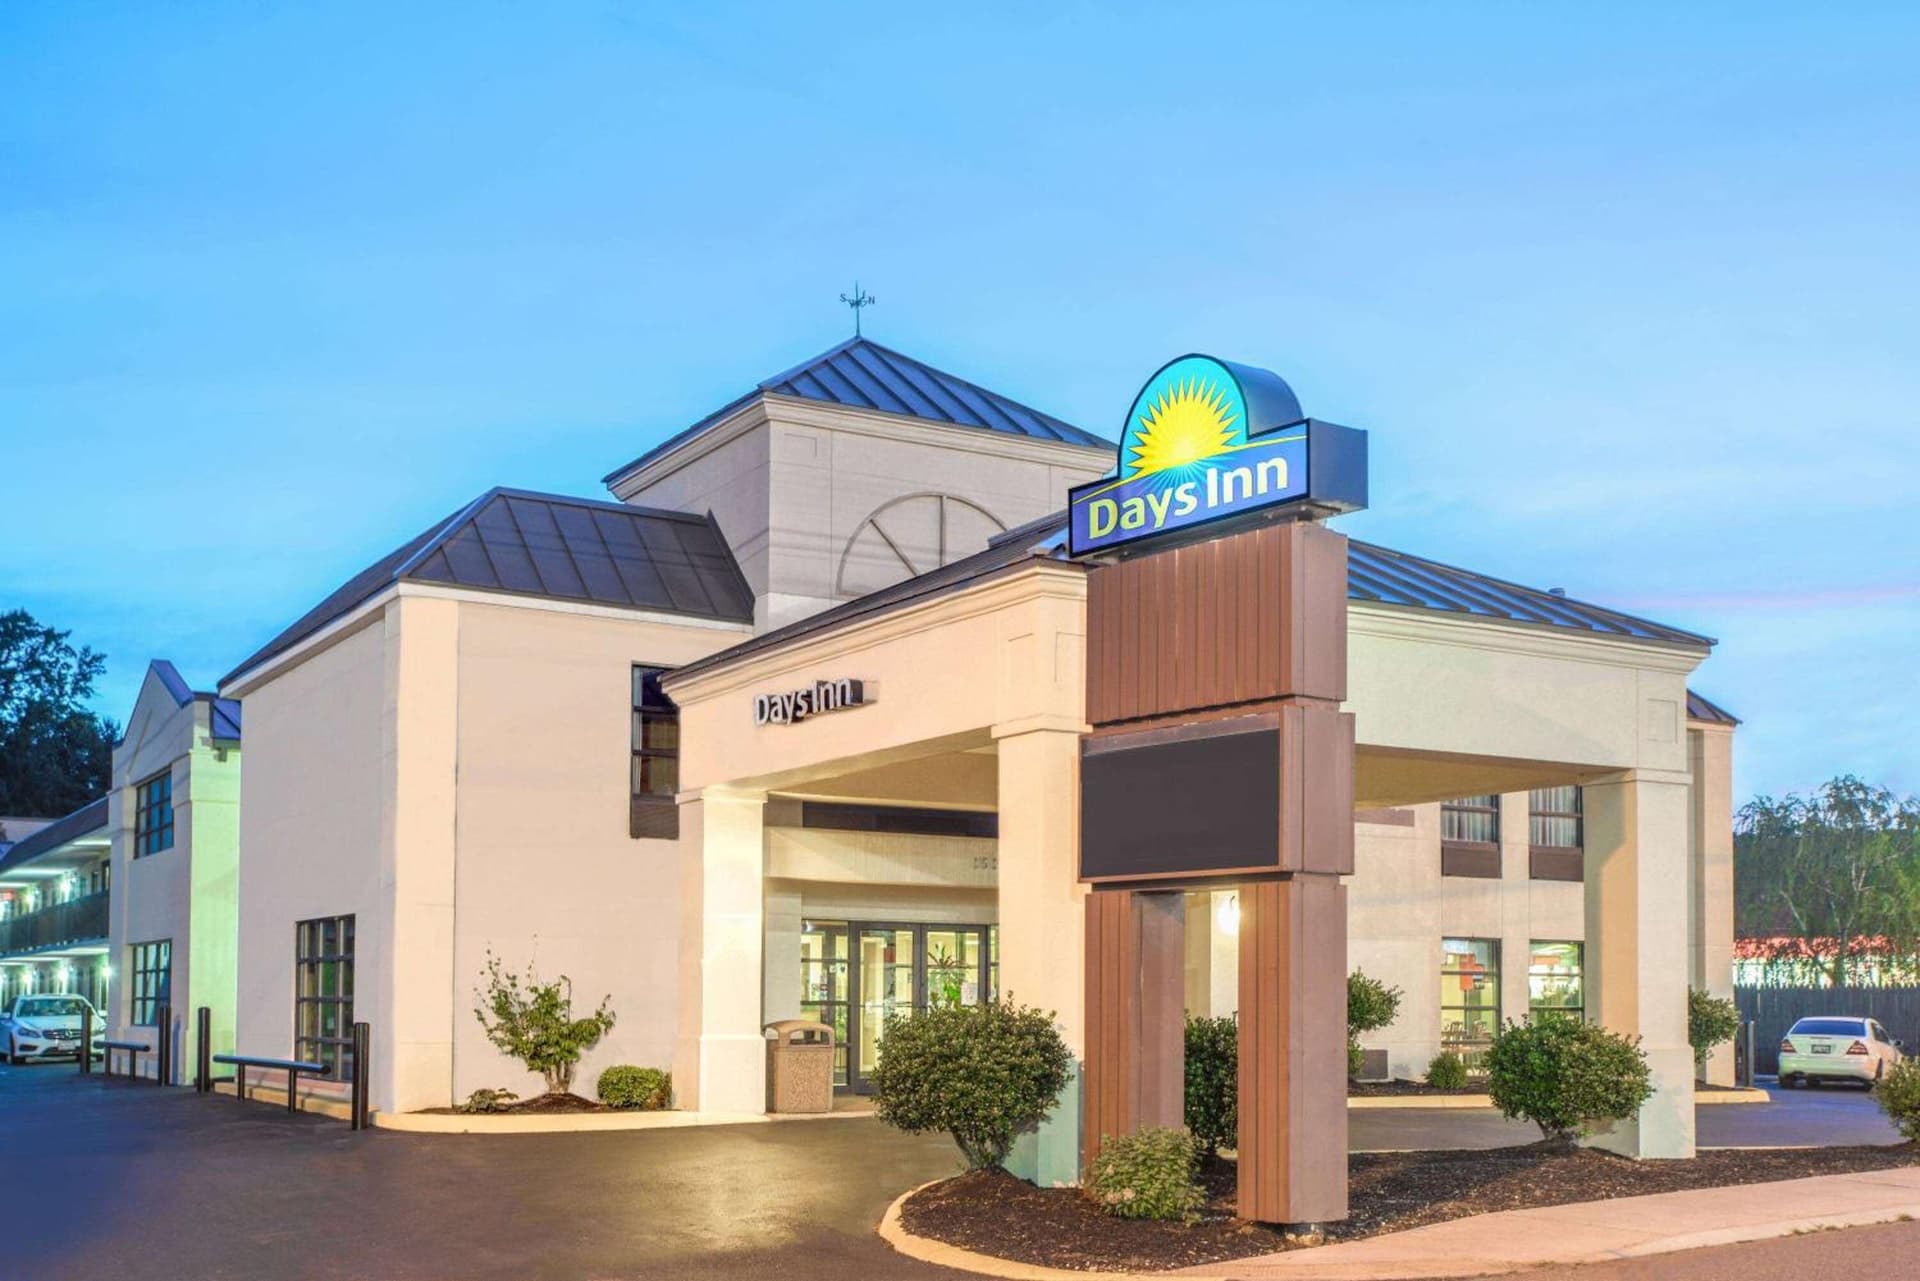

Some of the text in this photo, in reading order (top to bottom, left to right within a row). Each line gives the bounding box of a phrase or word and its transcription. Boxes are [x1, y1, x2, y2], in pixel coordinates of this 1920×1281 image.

[1088, 456, 1288, 540] Days Inn
[755, 679, 850, 726] Days Inn
